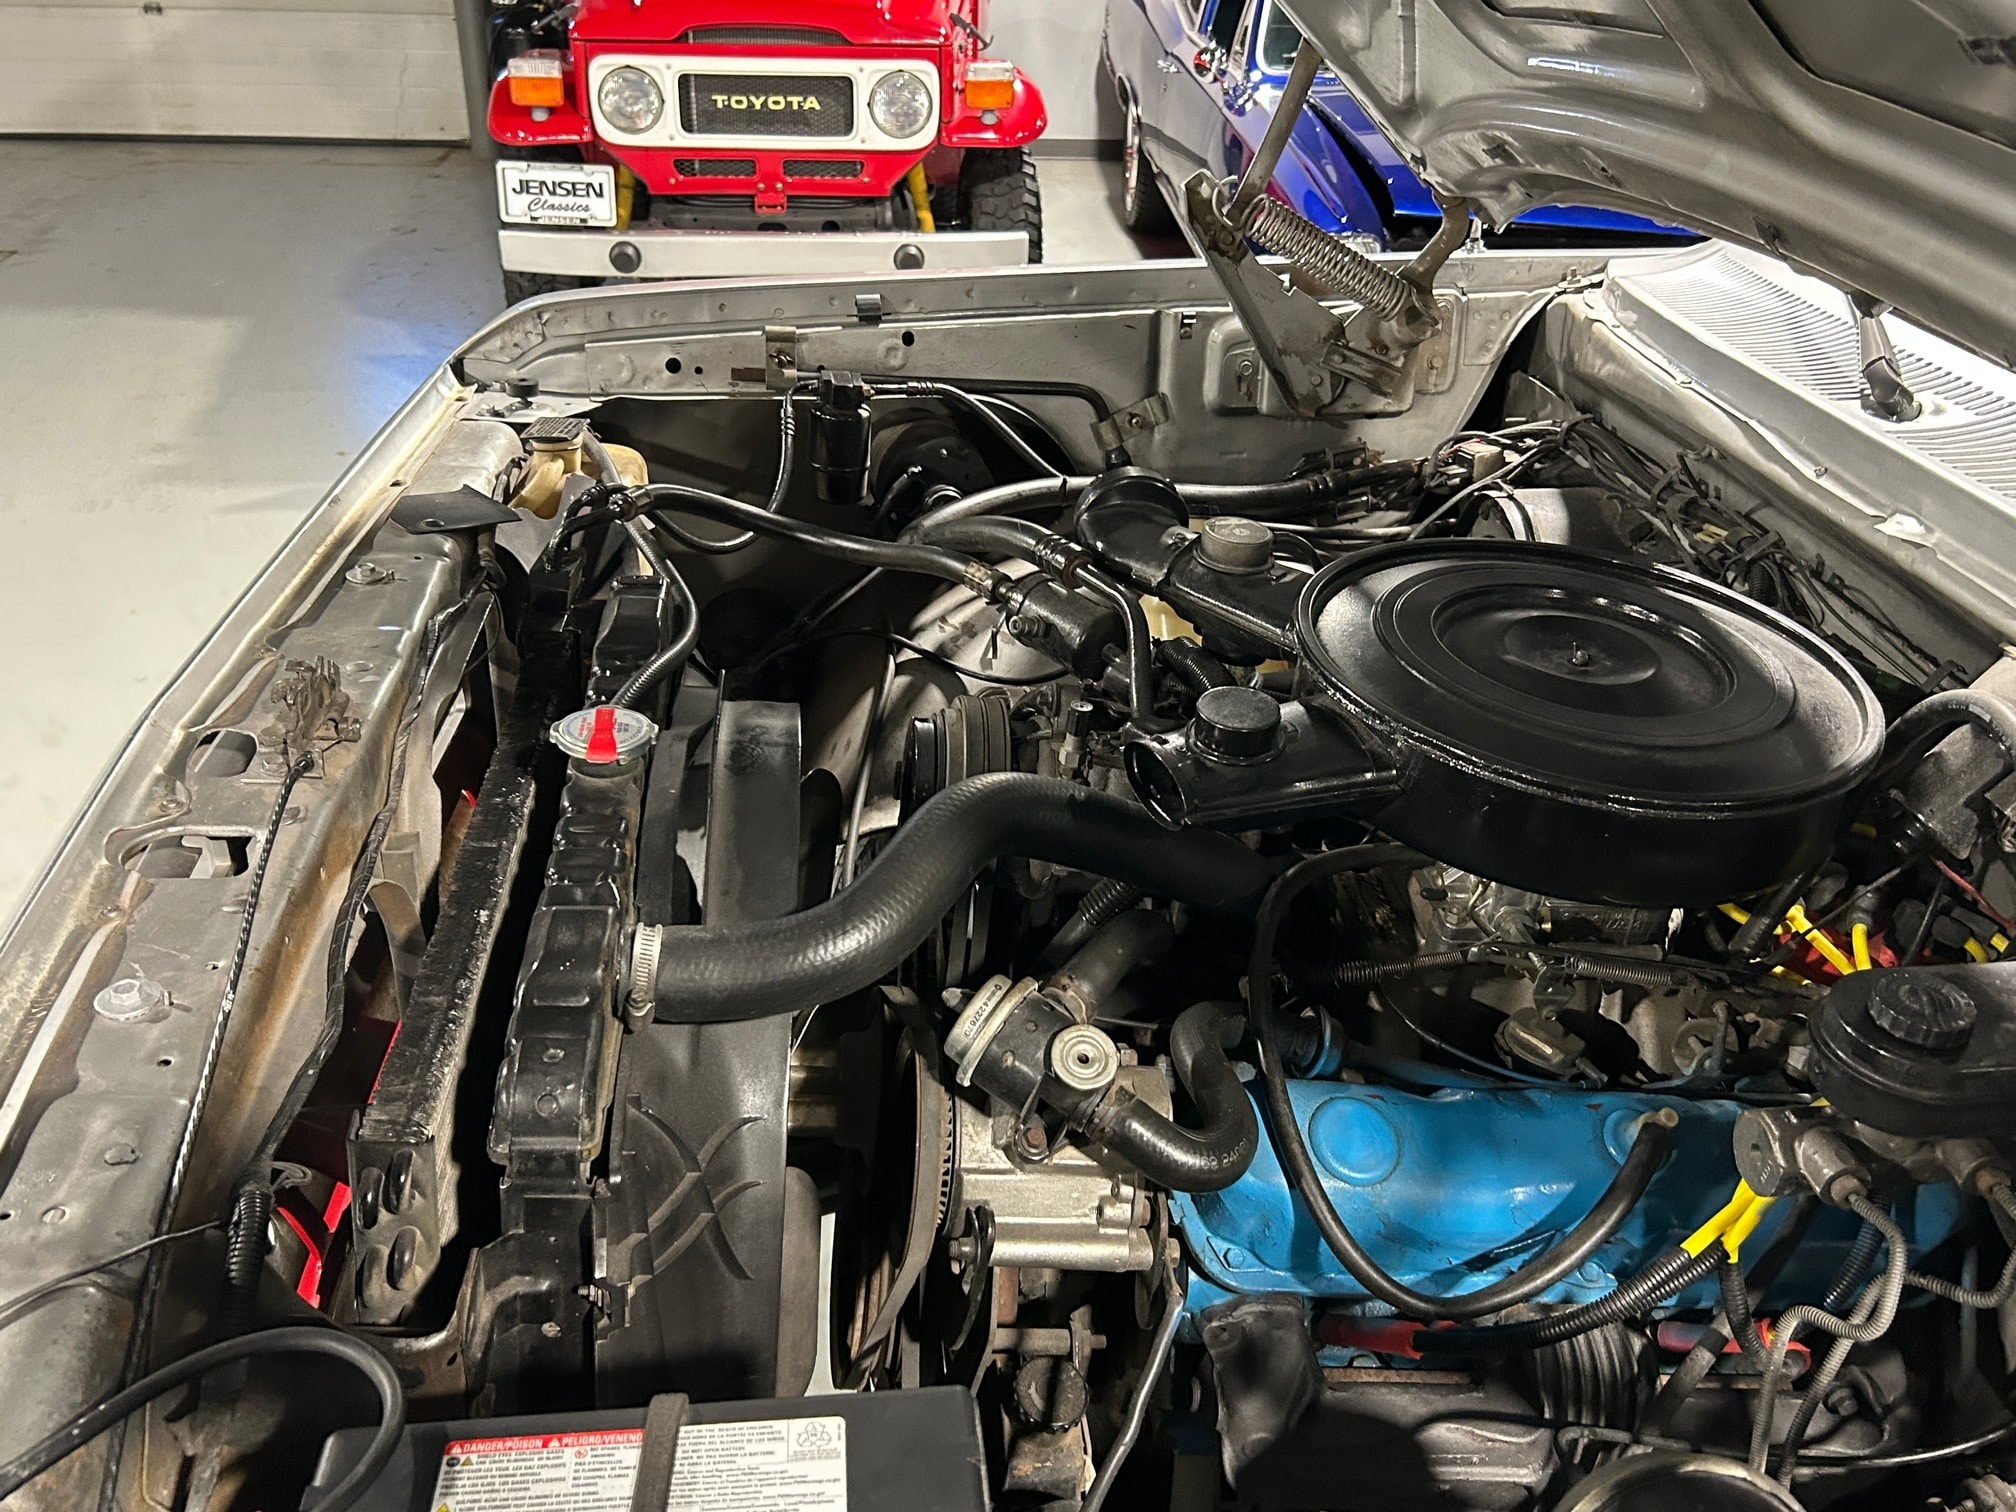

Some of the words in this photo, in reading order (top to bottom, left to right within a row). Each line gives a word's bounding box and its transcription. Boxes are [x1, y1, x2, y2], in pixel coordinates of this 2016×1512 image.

[711, 94, 821, 110] TOYOTA
[512, 179, 604, 198] JENSEN
[527, 197, 592, 213] Classics
[963, 1001, 989, 1037] 4227670
[464, 1439, 543, 1452] DANGER/POISON
[562, 1432, 643, 1446] PELIGRO/VENENO
